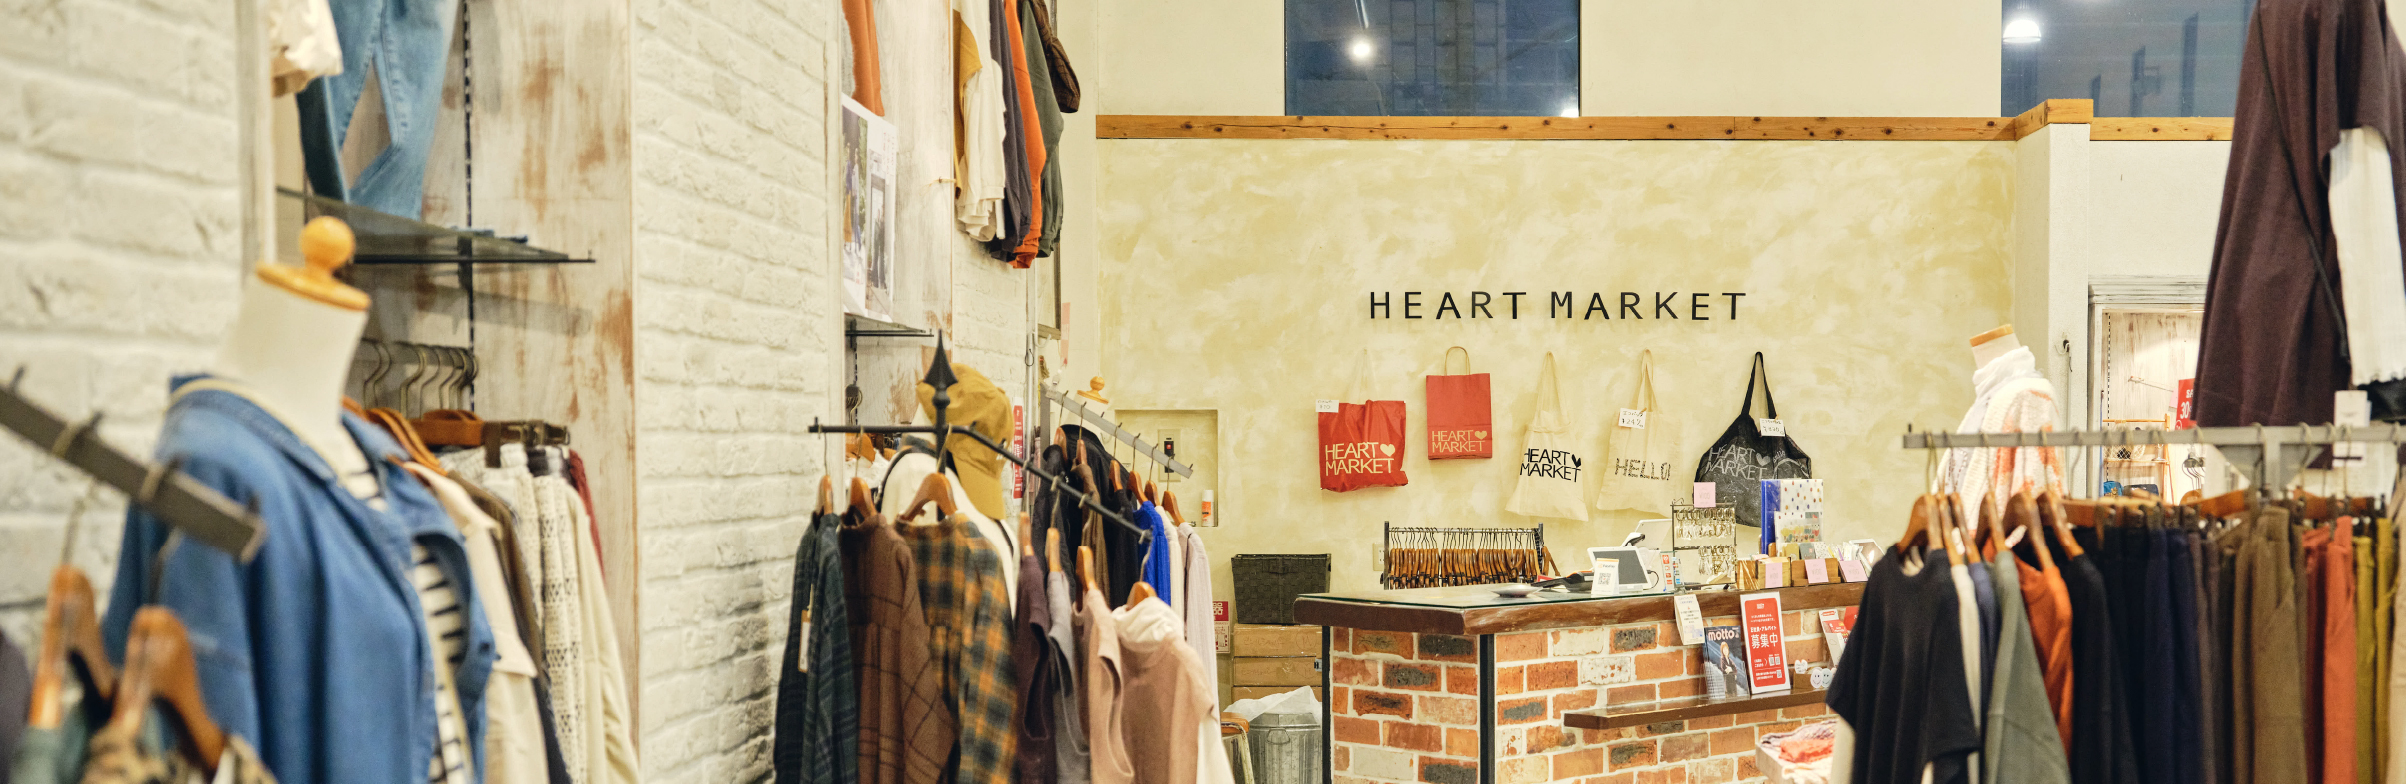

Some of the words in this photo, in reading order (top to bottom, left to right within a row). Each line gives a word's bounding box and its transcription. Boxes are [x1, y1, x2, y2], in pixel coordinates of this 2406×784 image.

[1370, 291, 1527, 320] HEART
[1551, 291, 1747, 321] MARKET
[1432, 430, 1474, 442] HEART
[1325, 442, 1379, 461] HEART
[1432, 440, 1486, 453] MARKET
[1708, 444, 1756, 465] HEART
[1325, 458, 1394, 476] MARKET
[1519, 463, 1582, 483] MARKET
[1708, 628, 1735, 642] motto
[1750, 632, 1778, 650] 募集中
